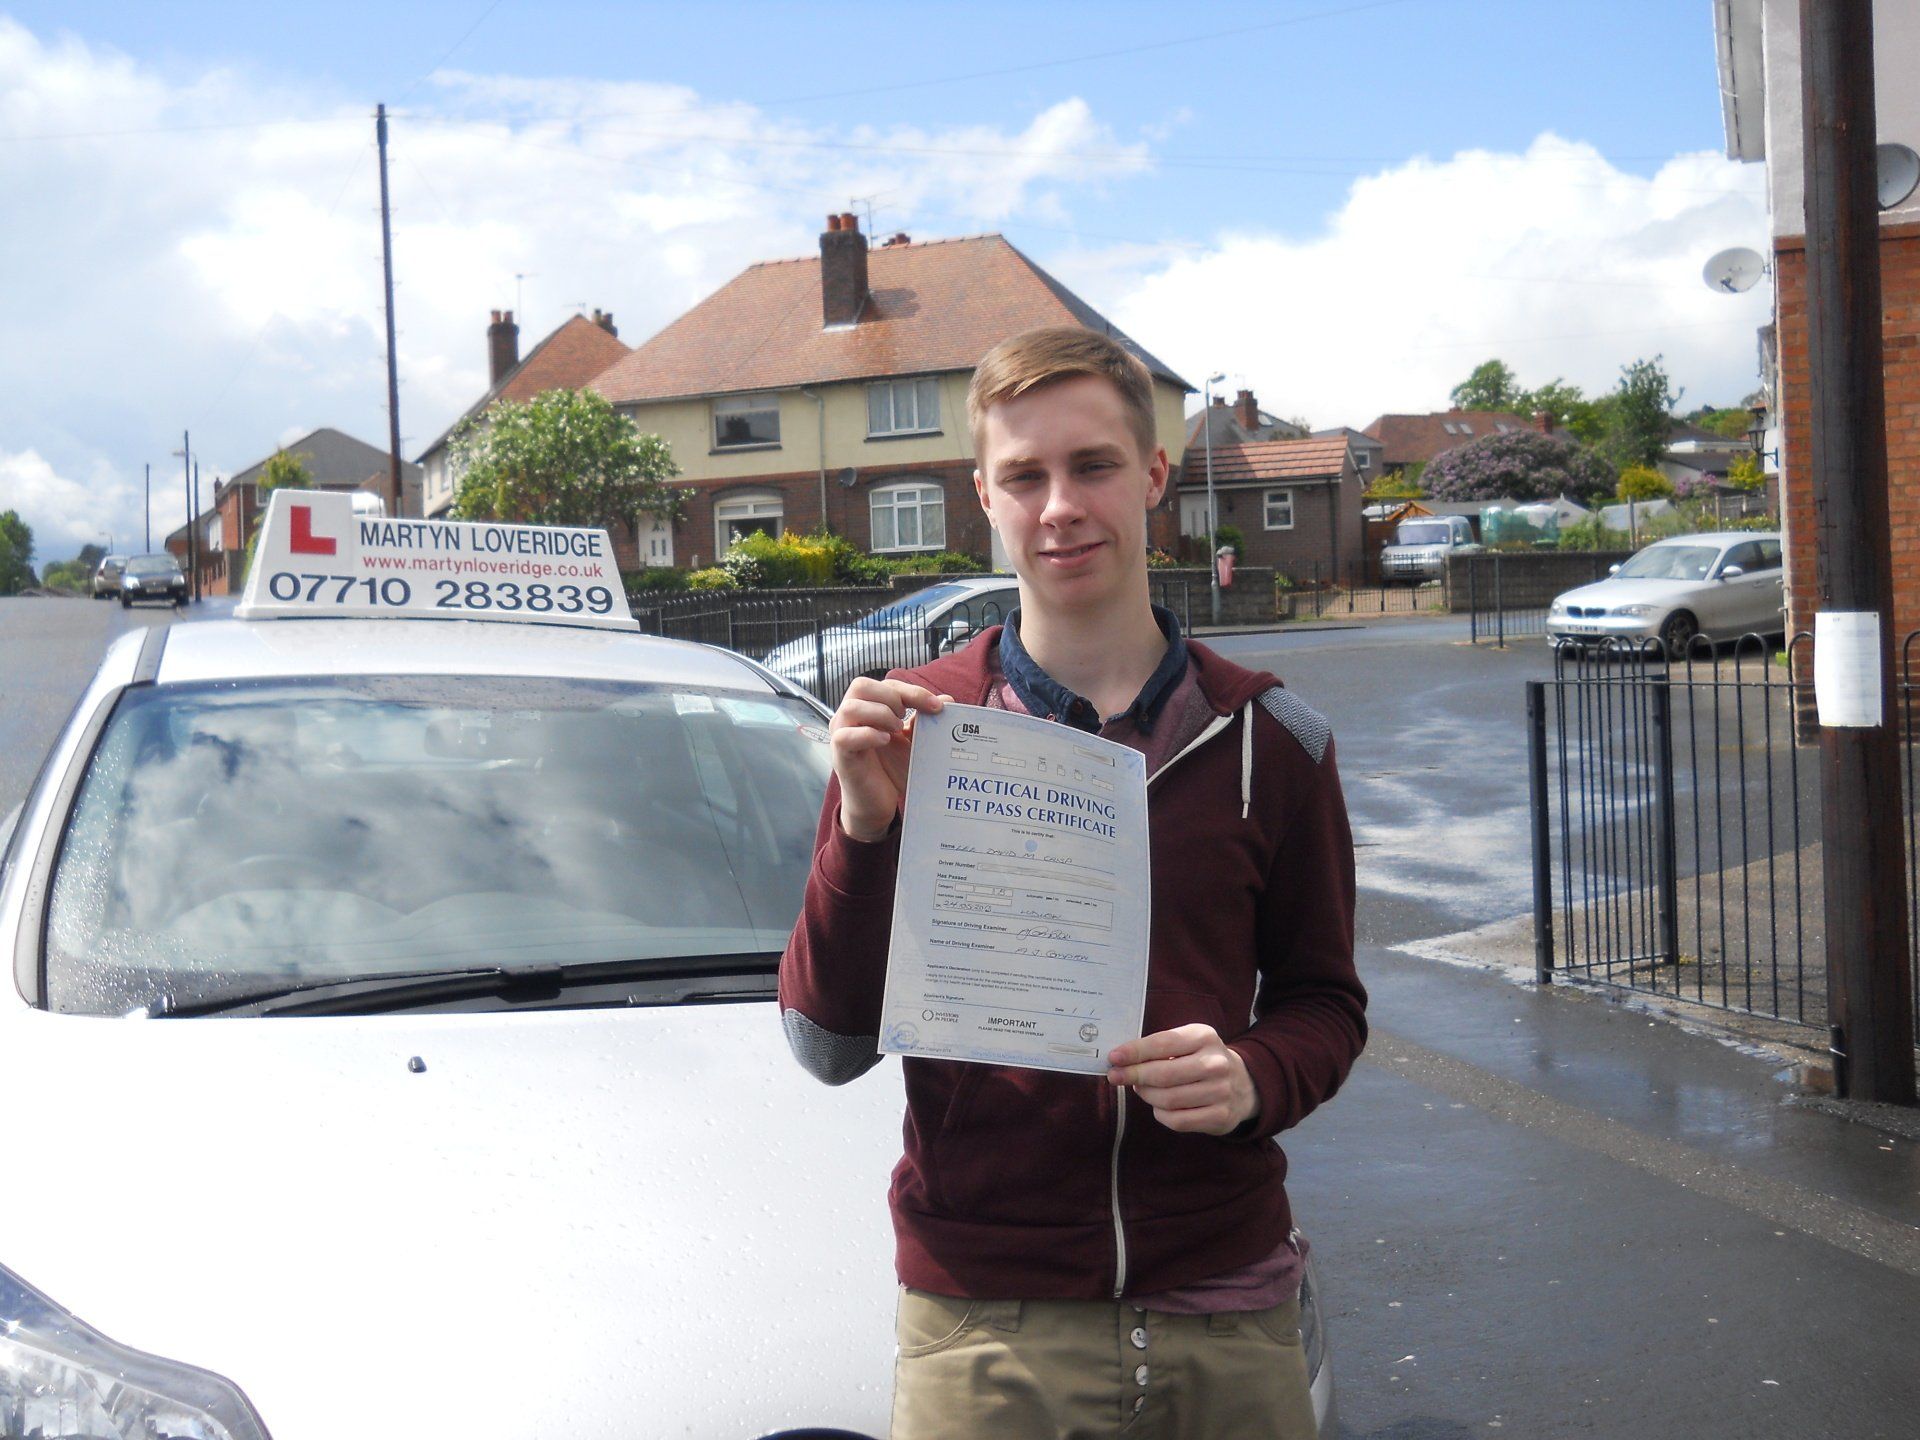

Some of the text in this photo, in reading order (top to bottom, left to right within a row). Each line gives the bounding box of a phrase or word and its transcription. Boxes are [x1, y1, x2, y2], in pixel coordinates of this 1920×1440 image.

[290, 505, 337, 555] L
[360, 521, 603, 558] MARTYN LOVERIDGE
[363, 554, 603, 579] www.martynloveridge.co.uk
[269, 572, 613, 614] 07710 283839
[962, 723, 980, 735] DSA
[947, 775, 1116, 820] PRACTICAL DRIVING
[946, 796, 1116, 839] TEST PASS CERTIFICATE
[963, 922, 983, 930] Driving
[952, 940, 970, 948] Driving
[987, 1016, 1037, 1029] IMPORTANT
